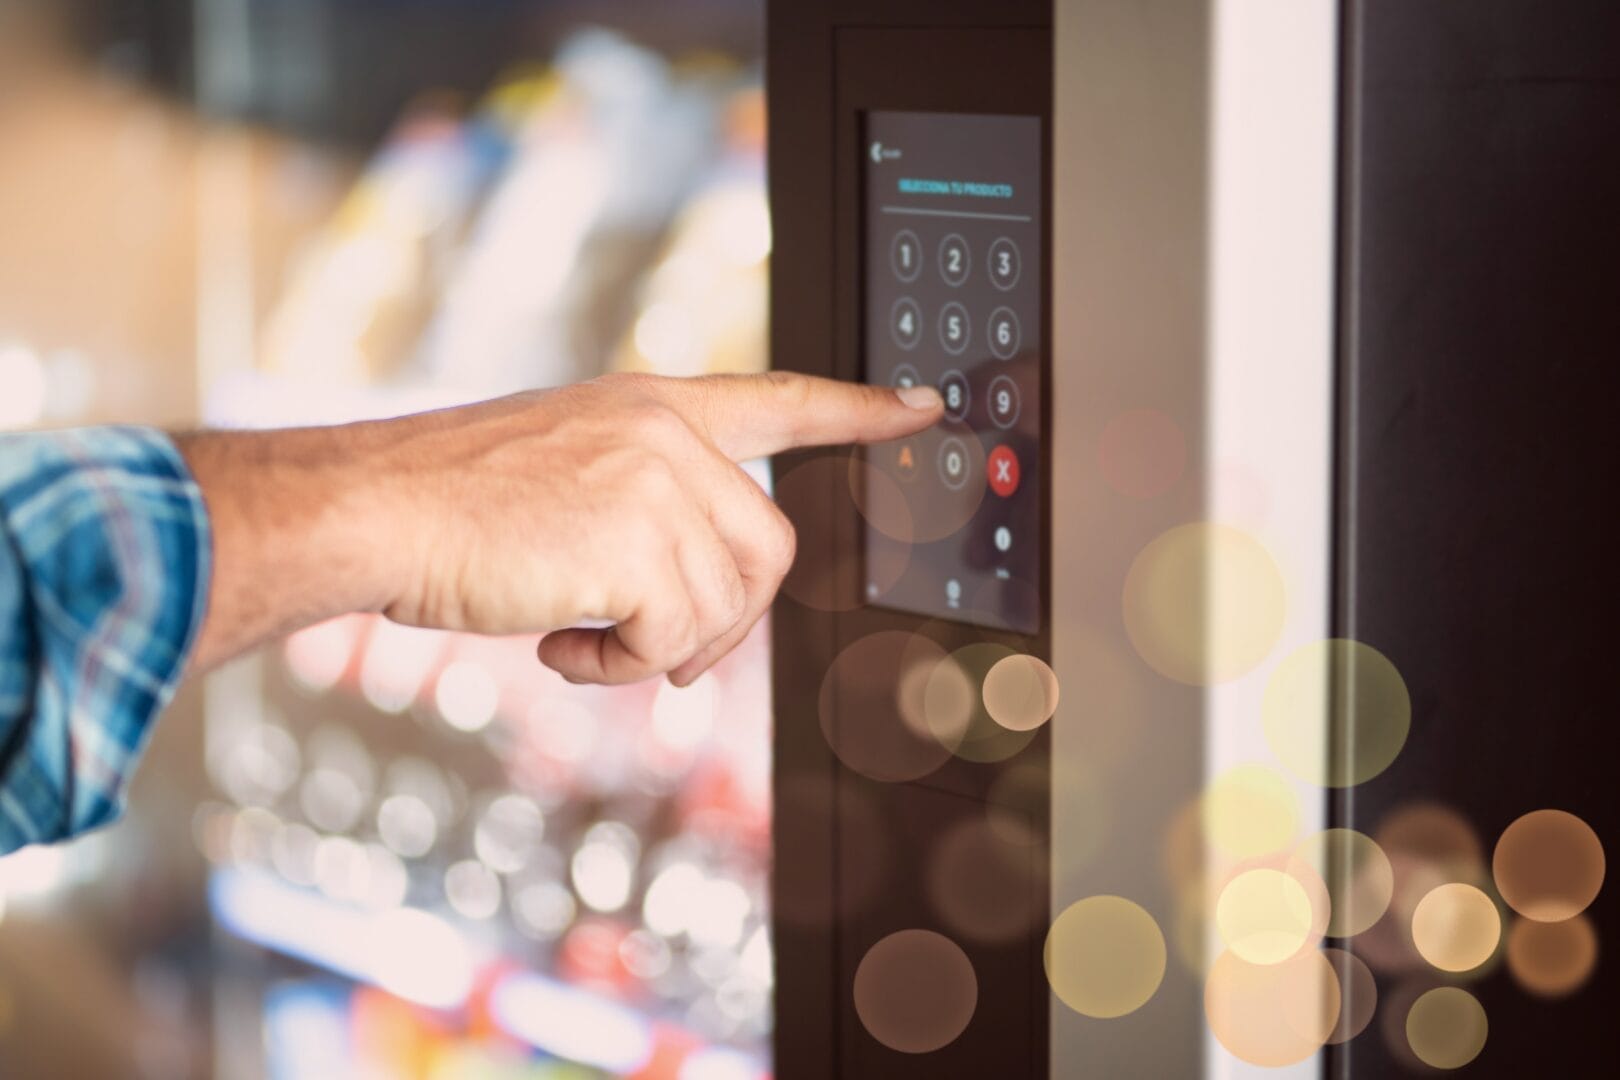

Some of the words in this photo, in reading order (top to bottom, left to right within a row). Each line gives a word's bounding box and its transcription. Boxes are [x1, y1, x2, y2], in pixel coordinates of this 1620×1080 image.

[901, 244, 911, 268] 1
[948, 248, 961, 272] 2
[998, 252, 1011, 276] 3
[899, 312, 914, 335] 4
[948, 316, 961, 340] 5
[997, 322, 1011, 345] 6
[947, 384, 961, 408] 8
[997, 390, 1011, 414] 9
[899, 446, 913, 469] A
